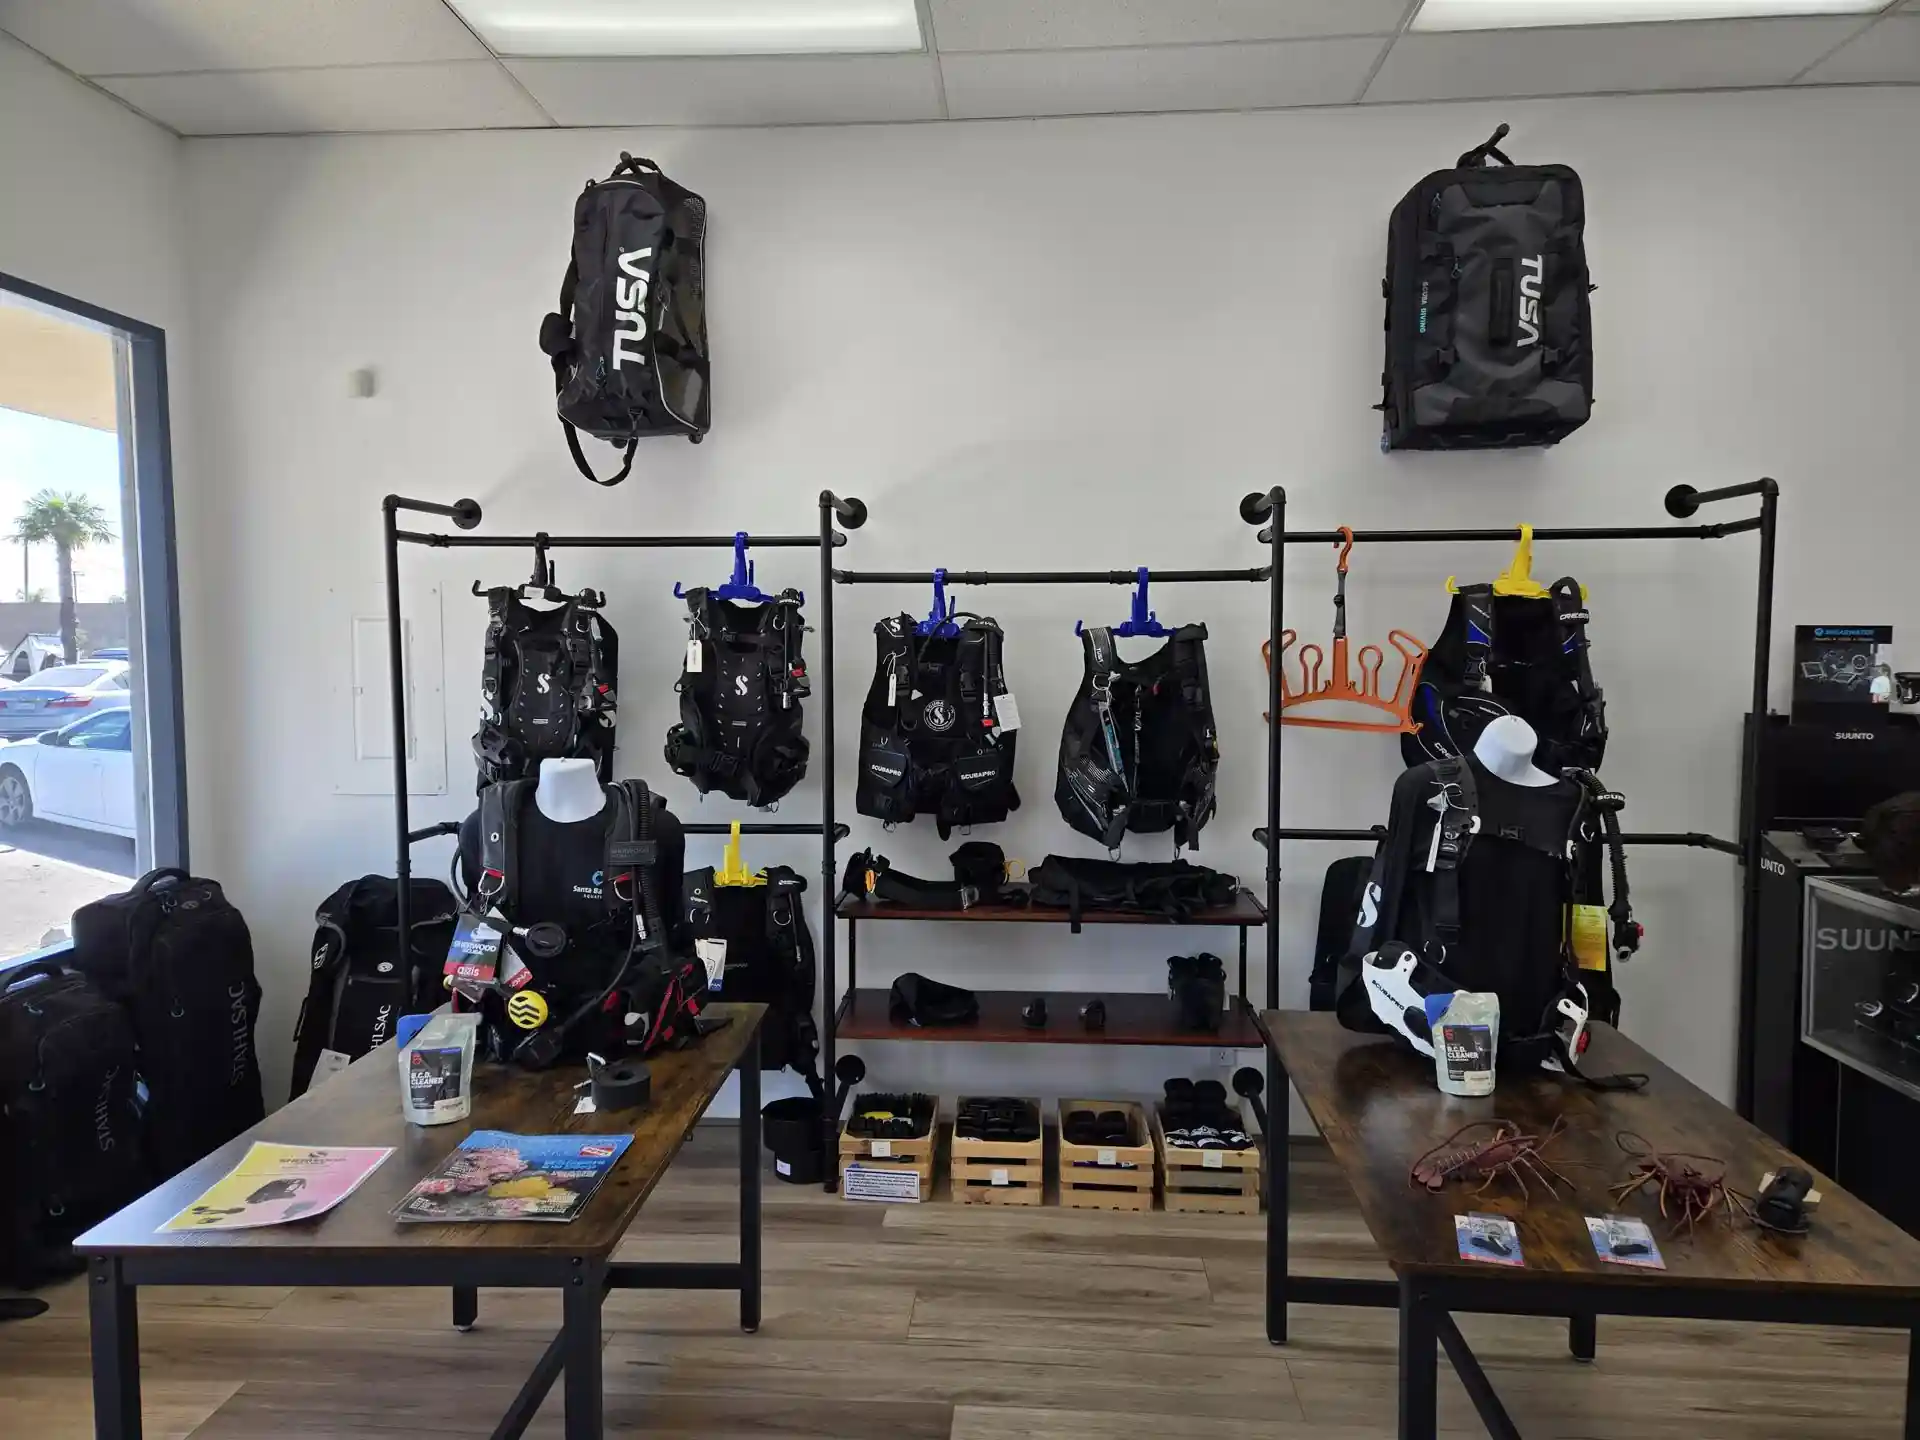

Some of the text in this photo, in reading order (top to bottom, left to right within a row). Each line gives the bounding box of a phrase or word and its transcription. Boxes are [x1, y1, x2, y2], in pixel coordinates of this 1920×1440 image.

[1516, 254, 1545, 347] TUSA
[613, 246, 653, 370] TUSA
[1835, 732, 1875, 741] SUUNTO
[871, 764, 902, 777] SCUBAPRO
[961, 770, 996, 780] SCUBAPRO
[572, 884, 593, 894] Santa
[1372, 979, 1405, 1011] SCUBAPRO
[228, 980, 247, 1089] STAHLSAC
[1447, 1051, 1479, 1059] CLEANER
[411, 1077, 444, 1085] CLEANER
